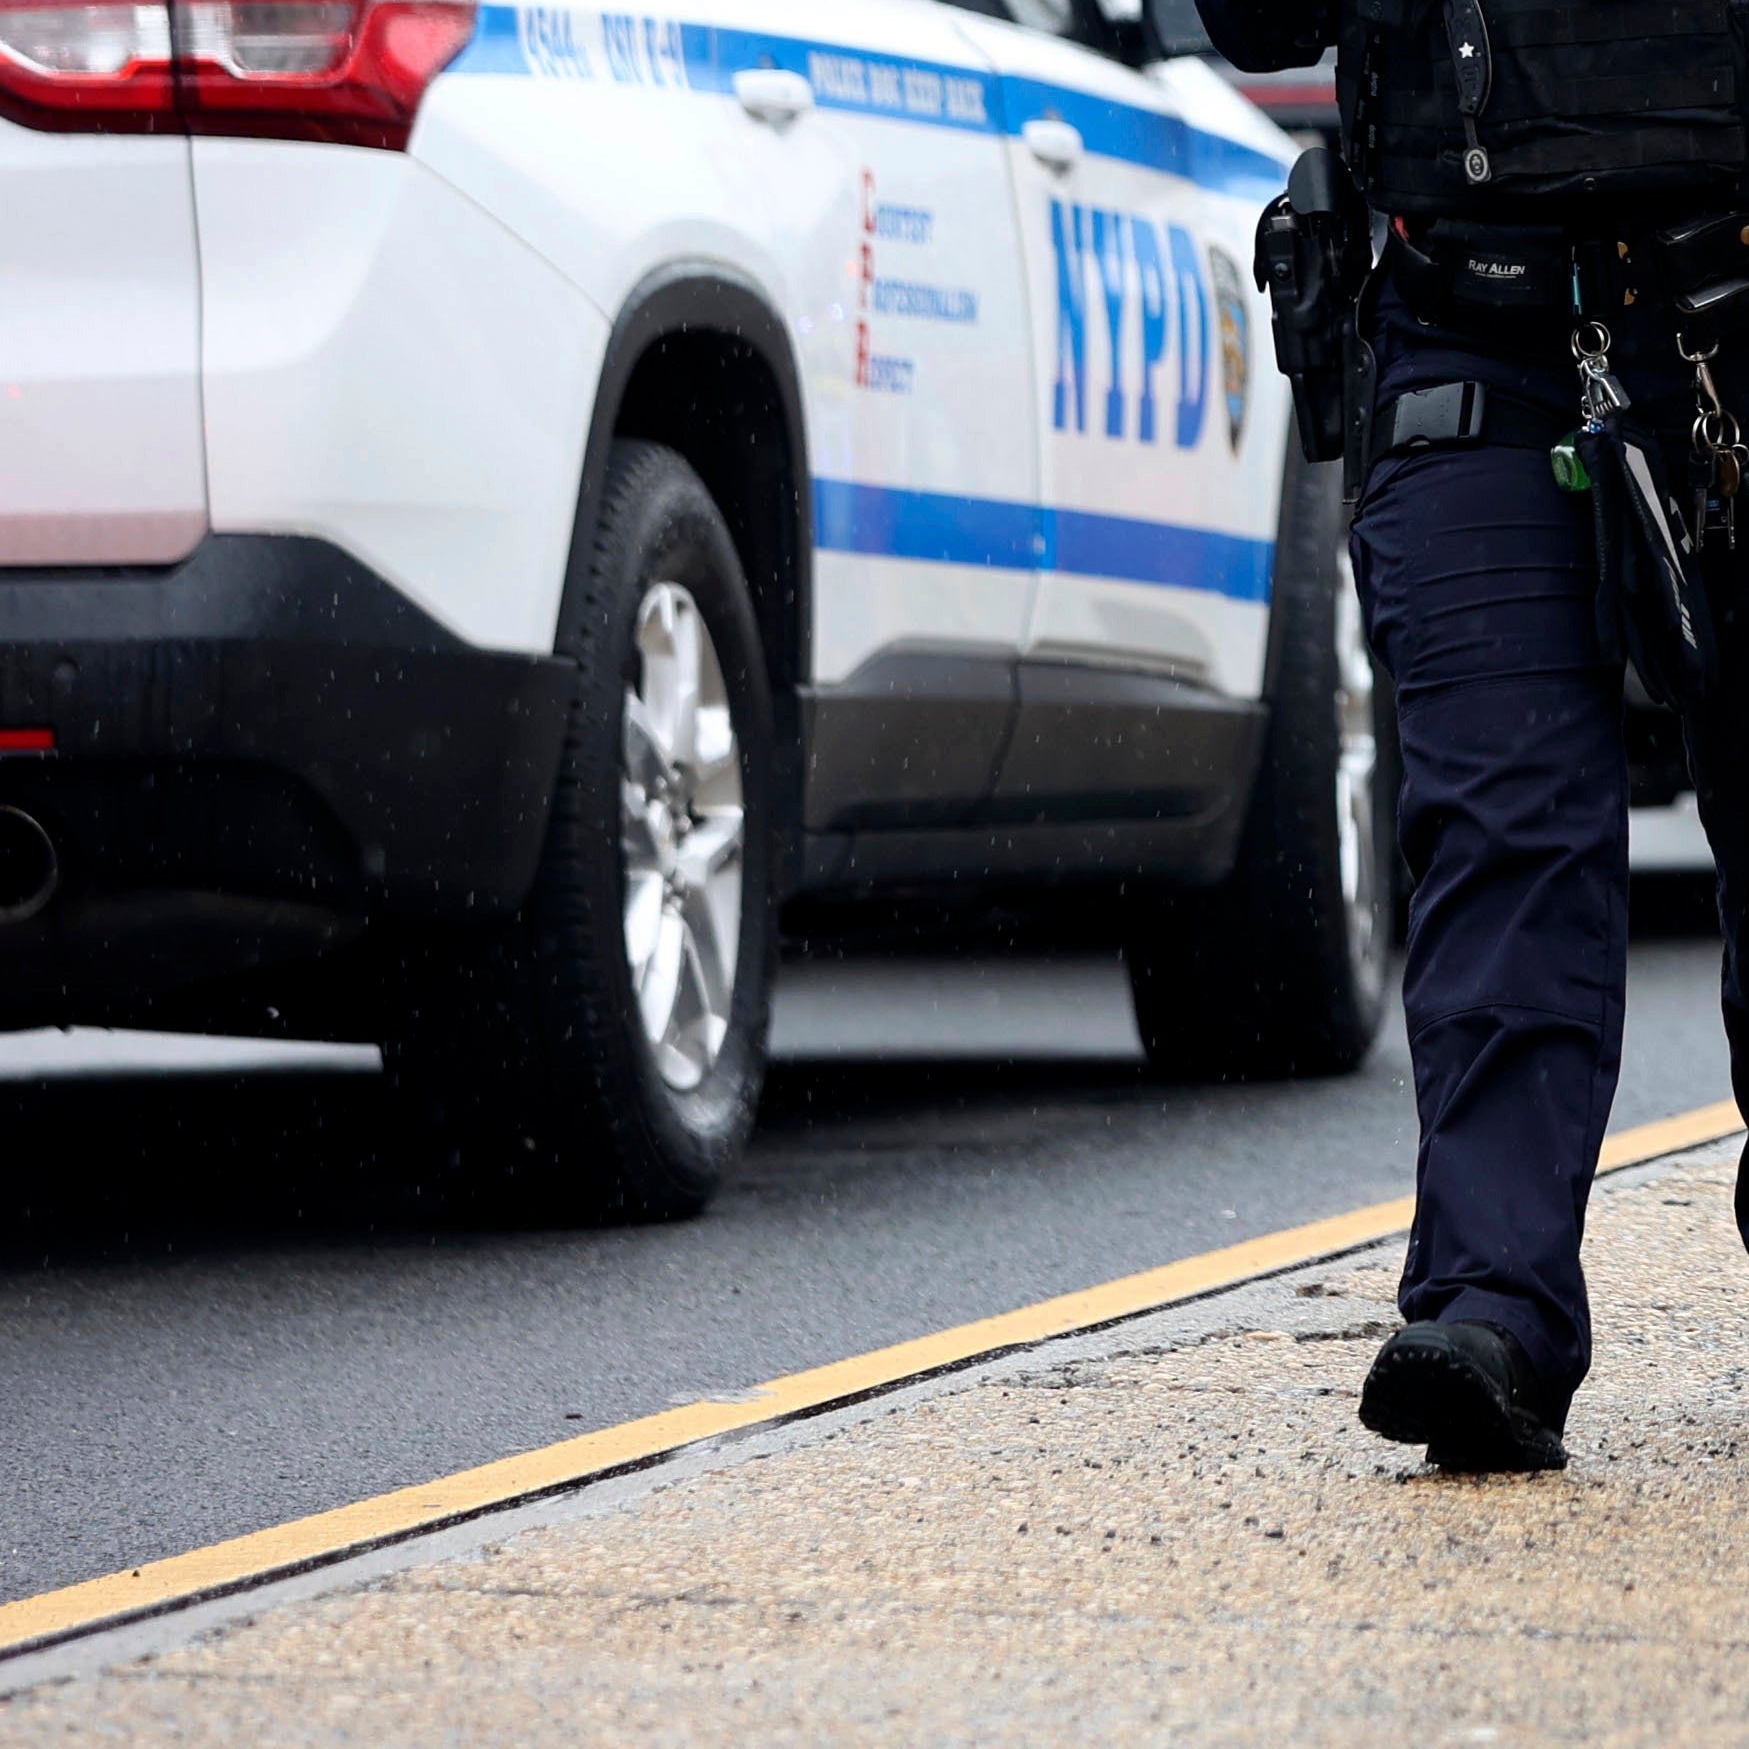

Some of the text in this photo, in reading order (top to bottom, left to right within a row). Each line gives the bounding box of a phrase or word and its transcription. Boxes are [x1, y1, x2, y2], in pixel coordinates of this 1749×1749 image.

[1050, 198, 1209, 449] NYPD
[1468, 259, 1488, 272] RAY
[1489, 263, 1526, 275] ALLEN
